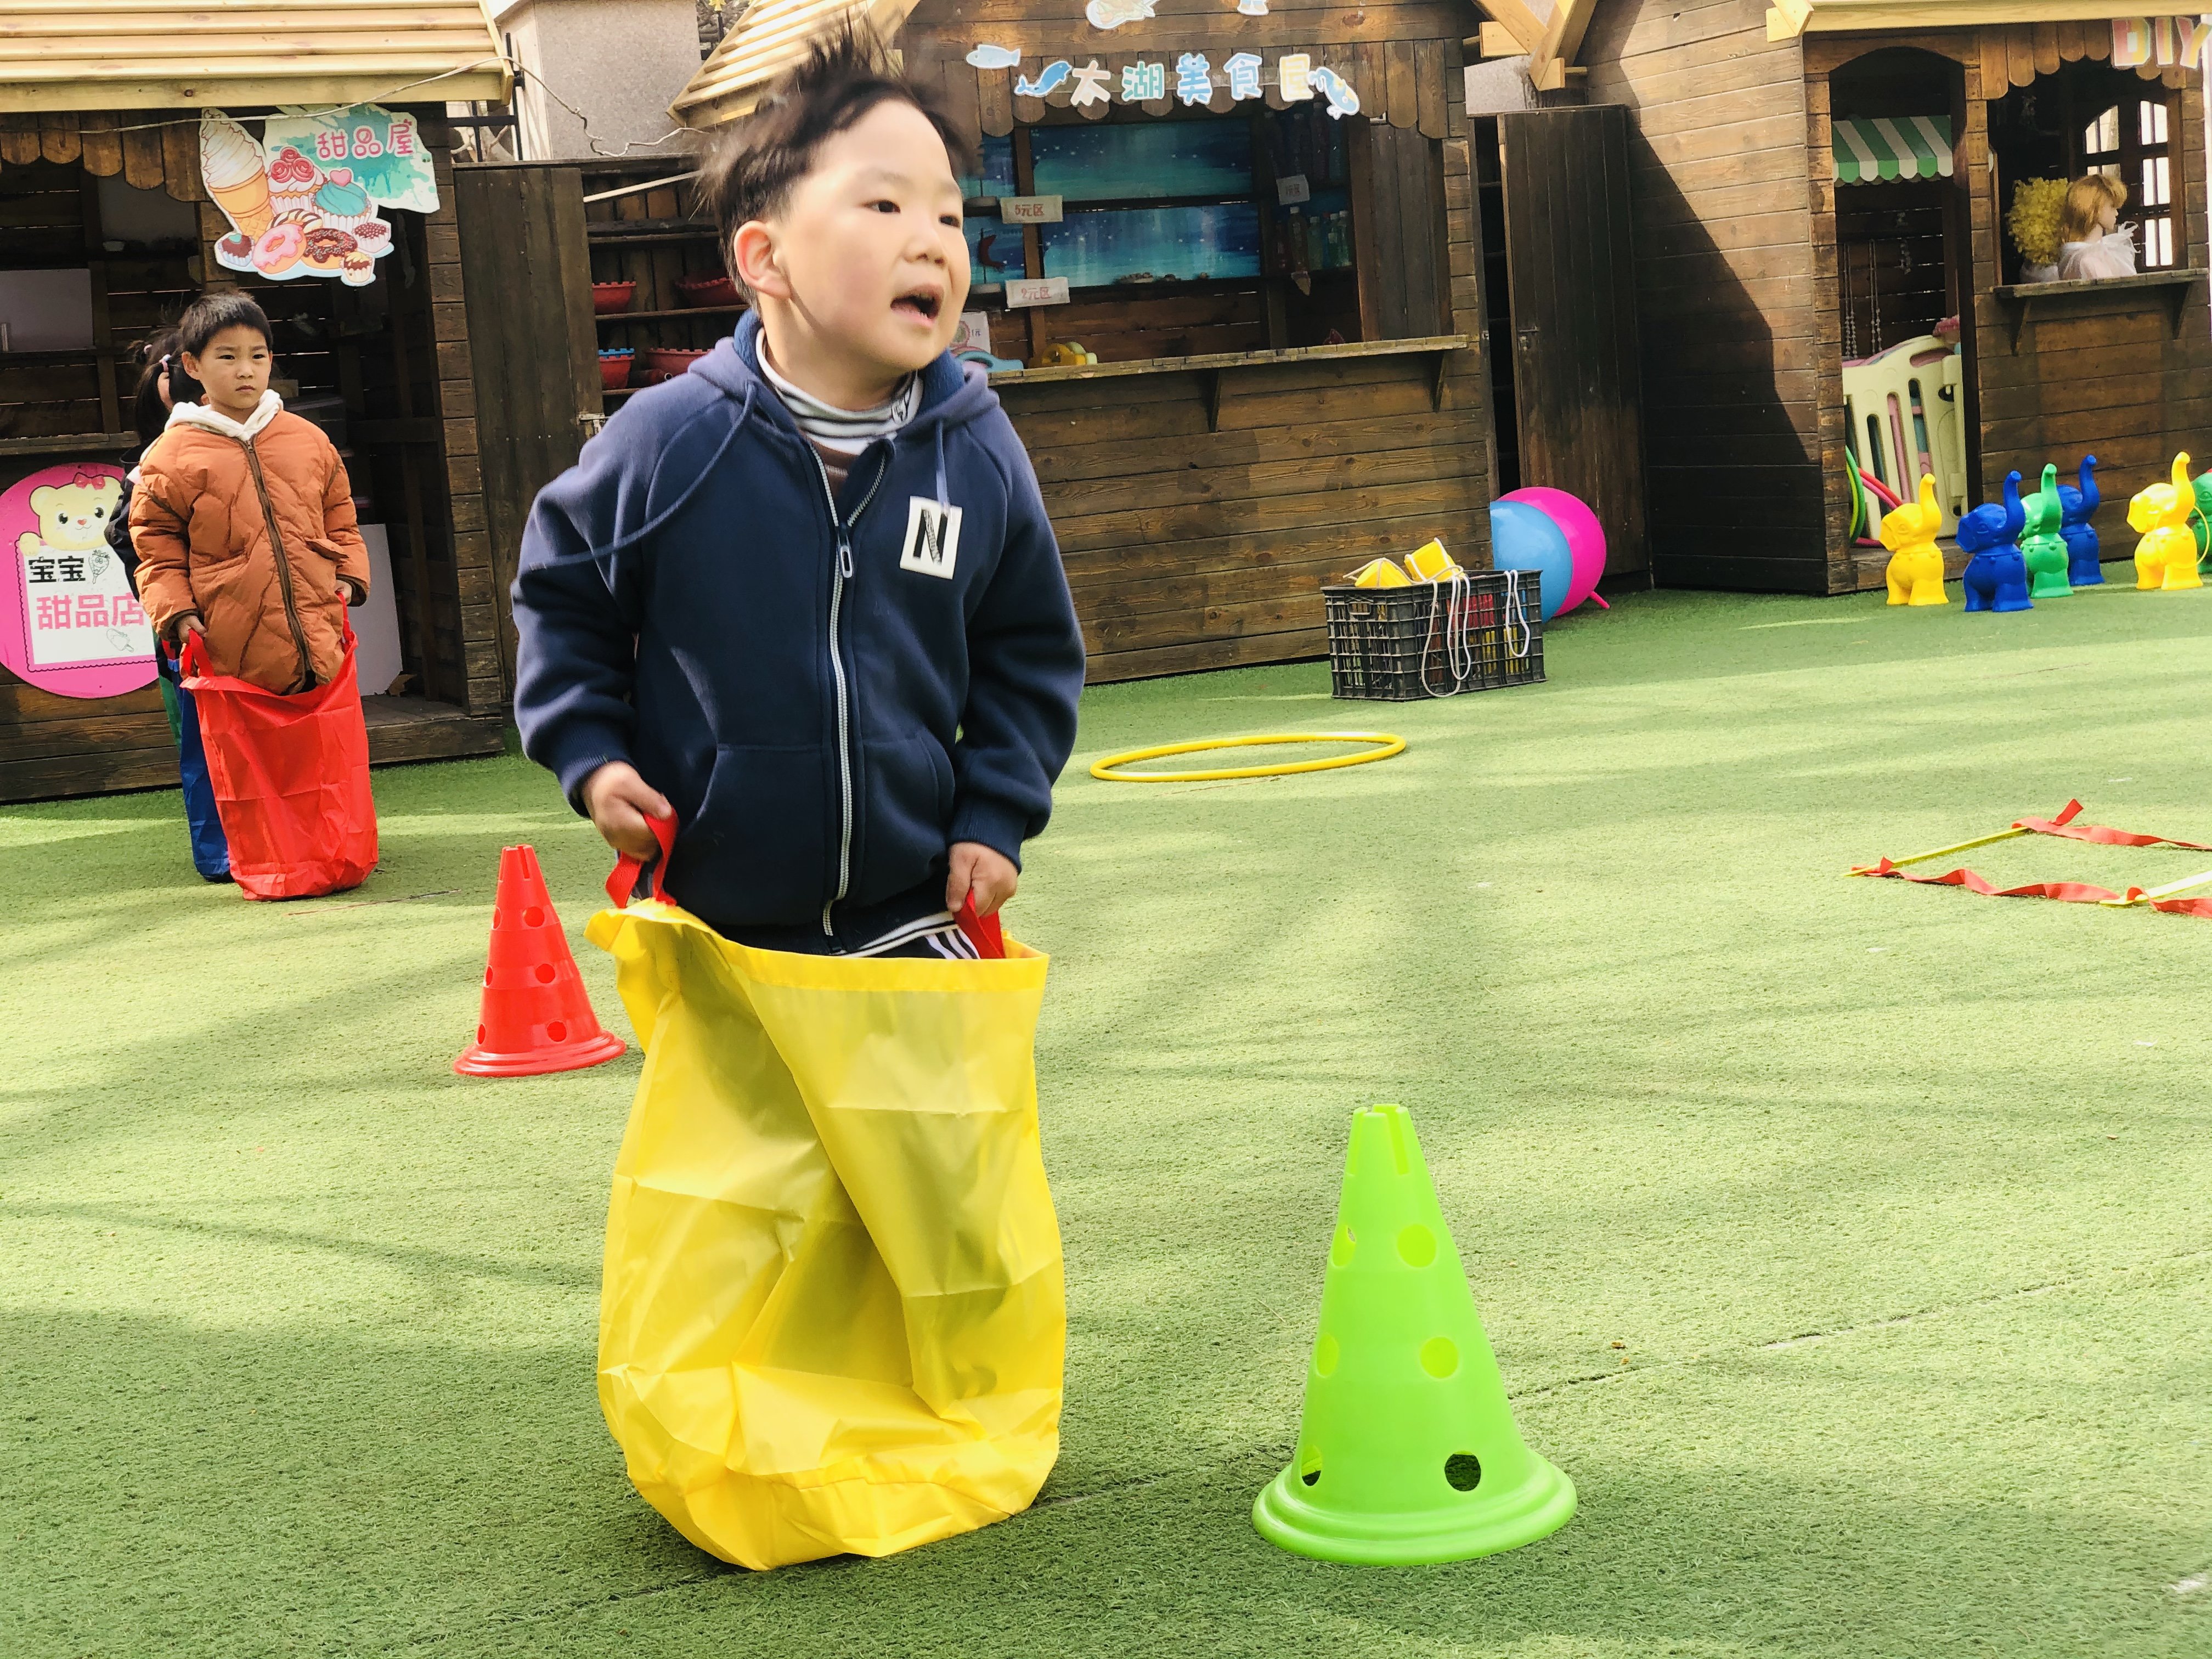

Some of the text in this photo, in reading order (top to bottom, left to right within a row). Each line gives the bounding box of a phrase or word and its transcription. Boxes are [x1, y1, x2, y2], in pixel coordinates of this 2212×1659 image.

[2113, 16, 2212, 69] DIY
[1071, 53, 1313, 105] 太湖美食屋
[317, 119, 414, 159] 甜品屋
[1015, 204, 1045, 217] 5元区
[1021, 286, 1052, 300] 2元区
[28, 556, 86, 583] 宝宝
[37, 592, 145, 630] 甜品店
